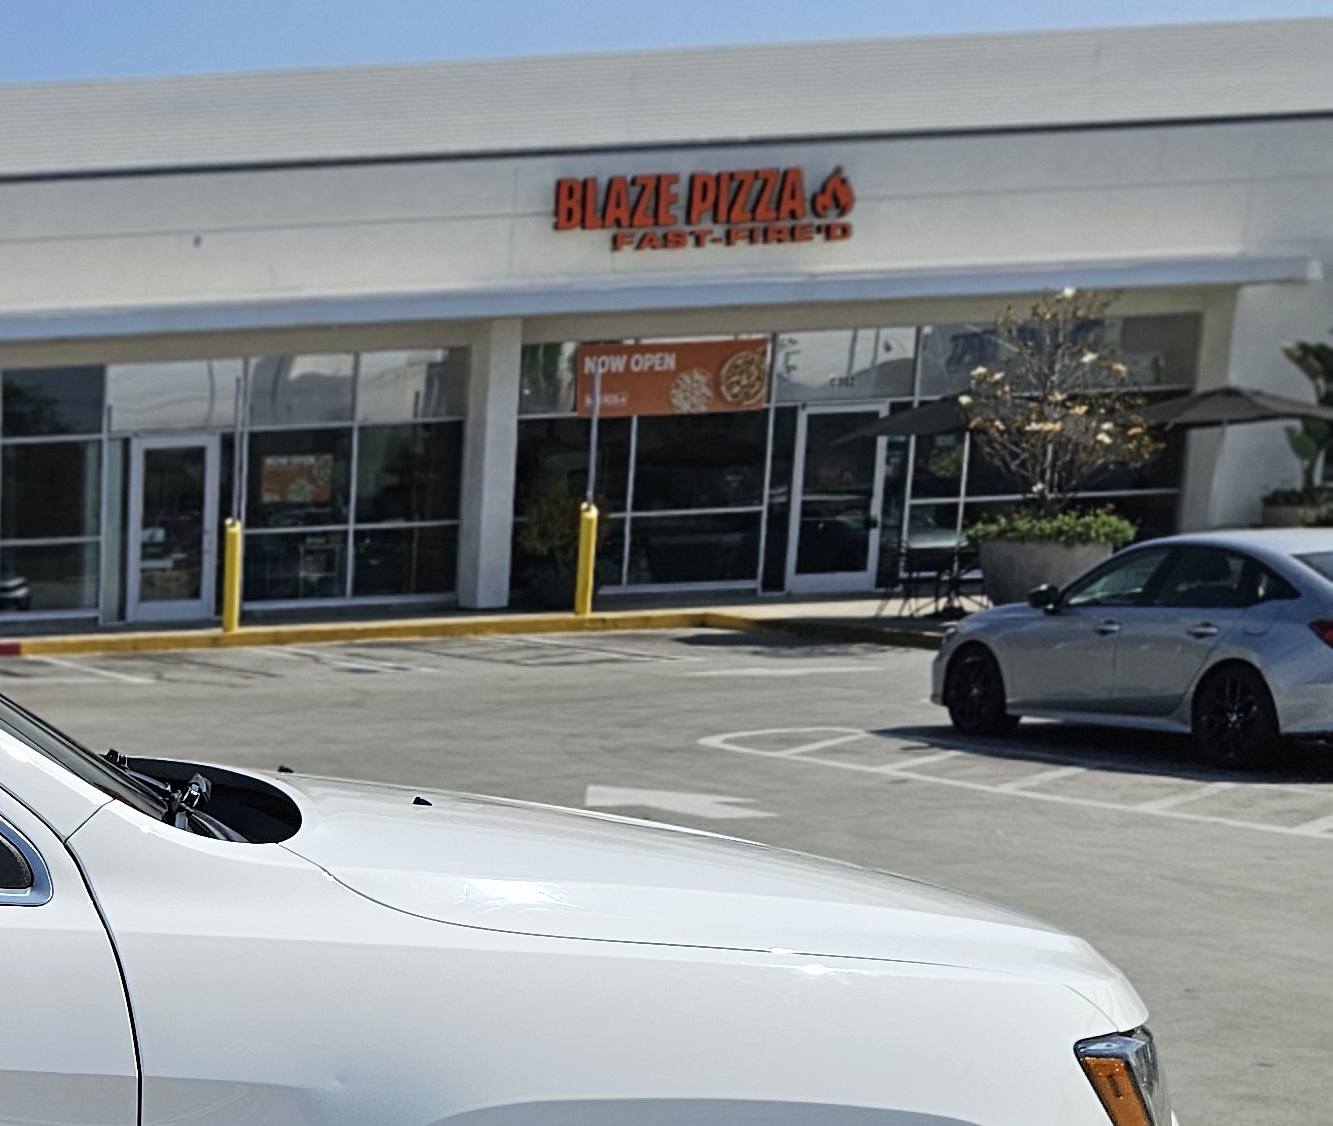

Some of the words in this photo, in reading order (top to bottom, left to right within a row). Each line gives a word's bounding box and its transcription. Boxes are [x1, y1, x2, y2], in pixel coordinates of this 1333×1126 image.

[554, 173, 679, 230] BLAZE
[687, 167, 806, 225] PIZZA
[611, 222, 852, 251] FAST-FIRE'D
[584, 353, 628, 374] NOW
[630, 351, 676, 373] OPEN
